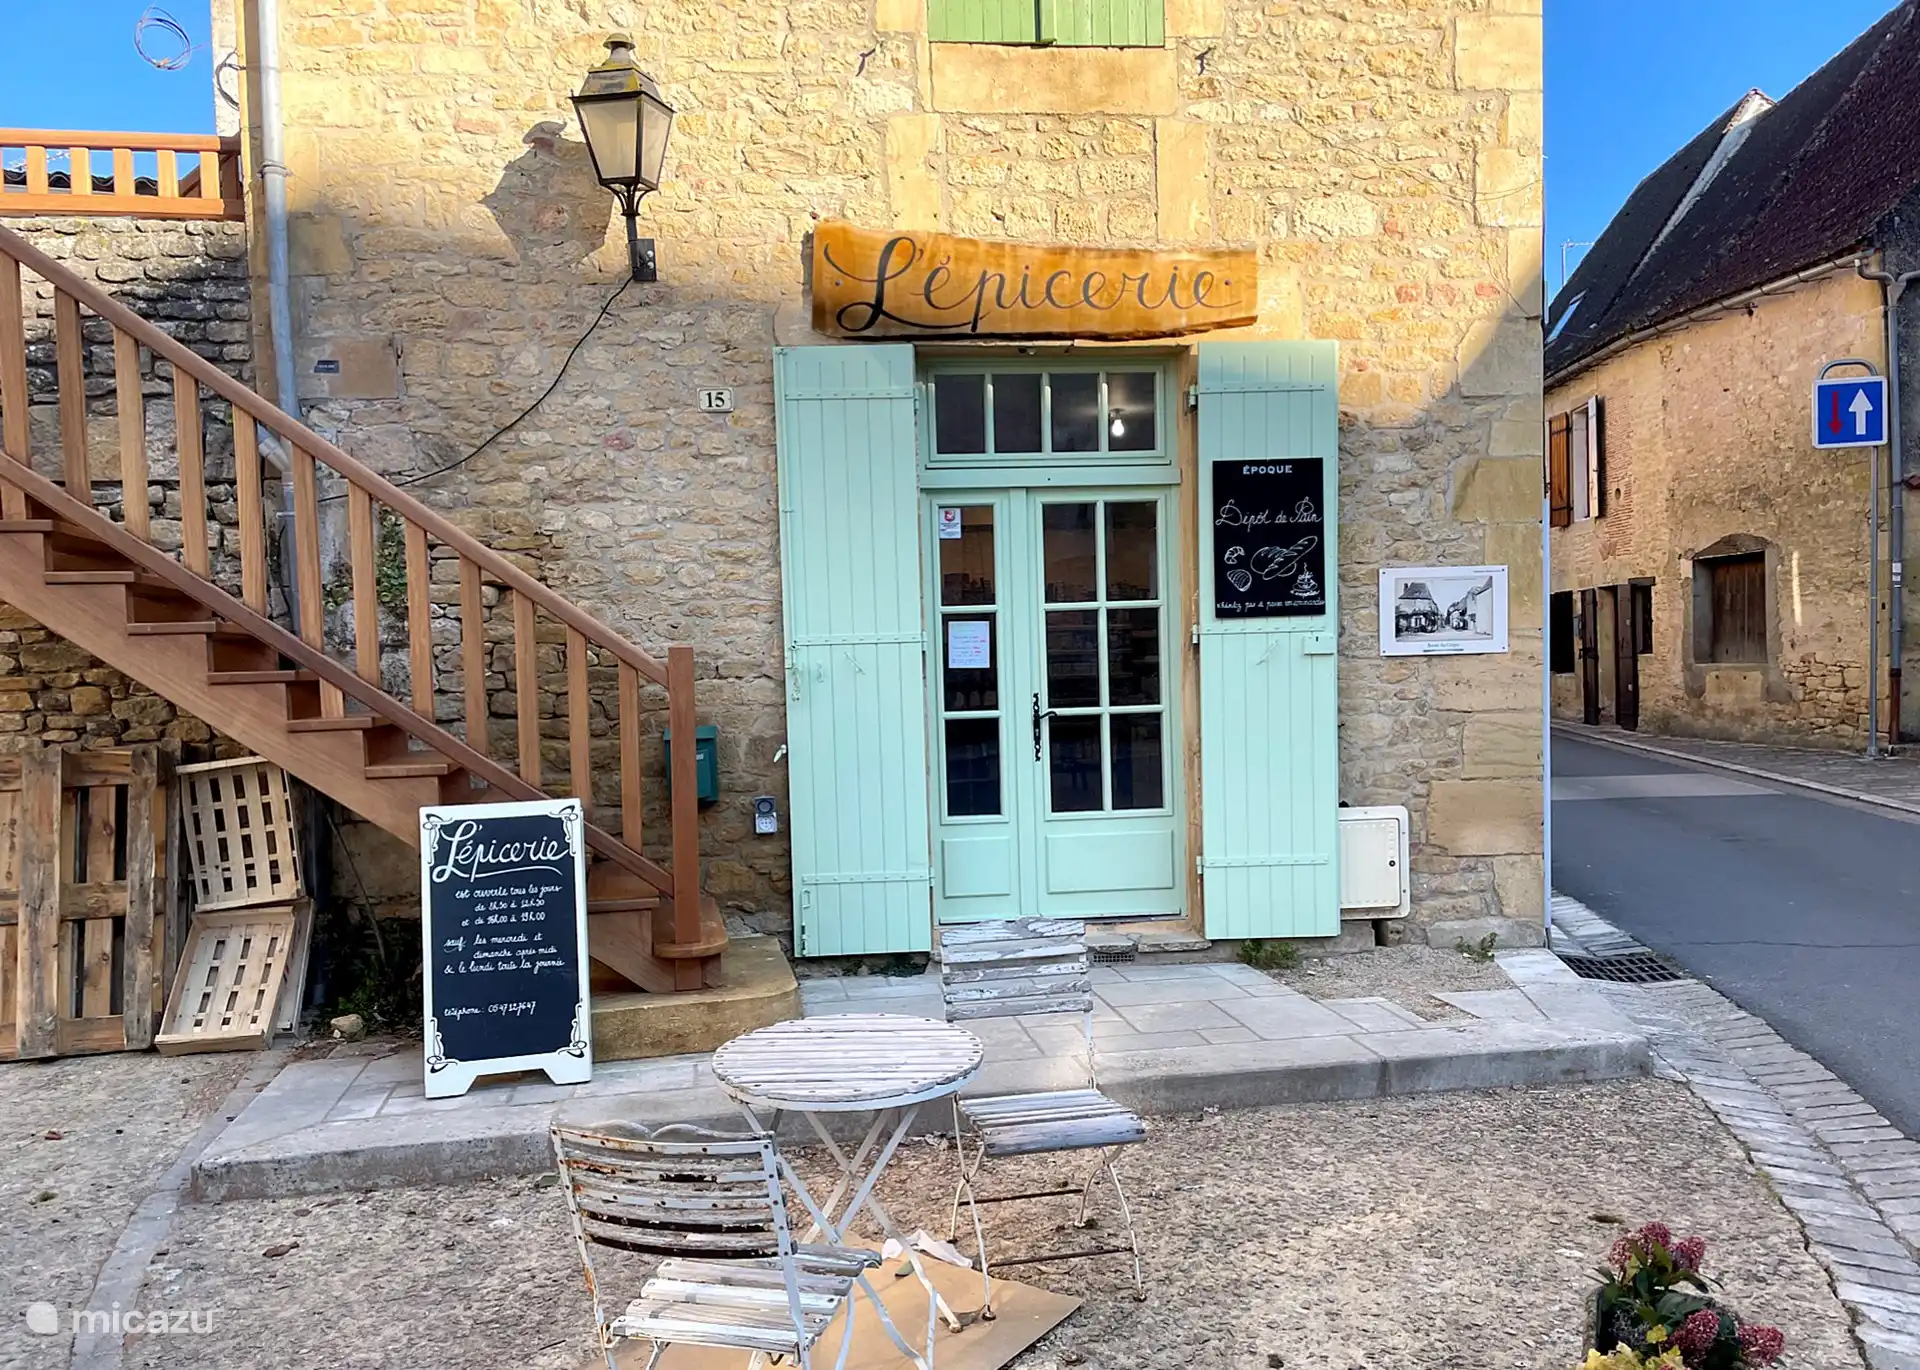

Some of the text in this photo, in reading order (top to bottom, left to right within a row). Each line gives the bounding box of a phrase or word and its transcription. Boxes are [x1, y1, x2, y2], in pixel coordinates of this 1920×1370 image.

[823, 236, 1244, 333] L'épicerie
[705, 392, 725, 408] 15
[1242, 464, 1293, 475] ÉPOQUE
[1215, 496, 1322, 532] Dépôt de Pain
[432, 820, 569, 883] L'épicerie
[455, 884, 563, 899] est ouverte tous les jours
[474, 903, 486, 912] de
[461, 919, 469, 927] et
[474, 916, 485, 925] de
[443, 936, 466, 951] sauf
[473, 934, 487, 945] les
[533, 932, 543, 941] et
[473, 948, 512, 959] dimanche
[538, 945, 558, 955] midi
[444, 957, 565, 974] & le lundi toute la journée
